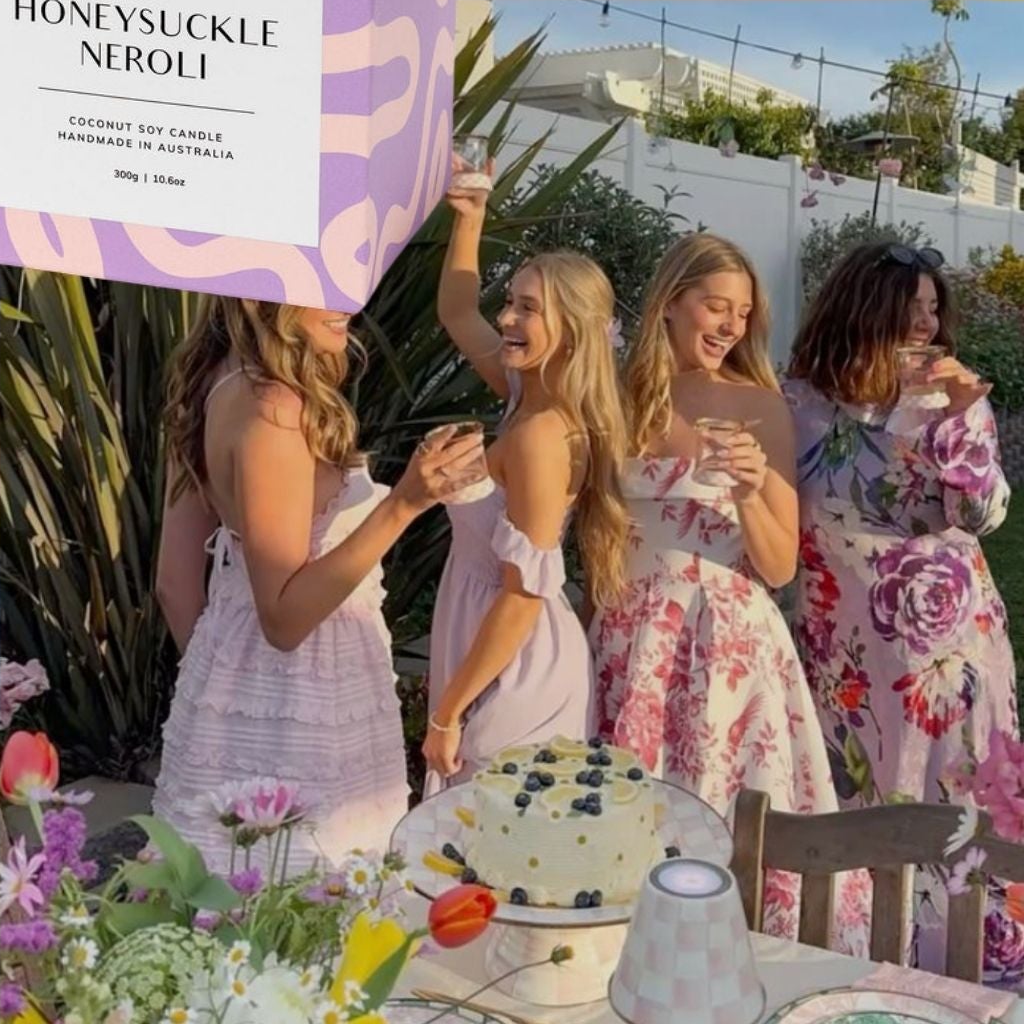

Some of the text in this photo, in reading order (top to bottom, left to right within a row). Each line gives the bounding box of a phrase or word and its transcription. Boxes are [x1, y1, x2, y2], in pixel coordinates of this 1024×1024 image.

[81, 40, 206, 80] NEROLI
[68, 116, 223, 143] COCONUT SOY CANDLE
[57, 130, 234, 160] HANDMADE IN AUSTRALIA
[113, 169, 139, 183] 300g
[153, 174, 185, 187] 10.6oz
